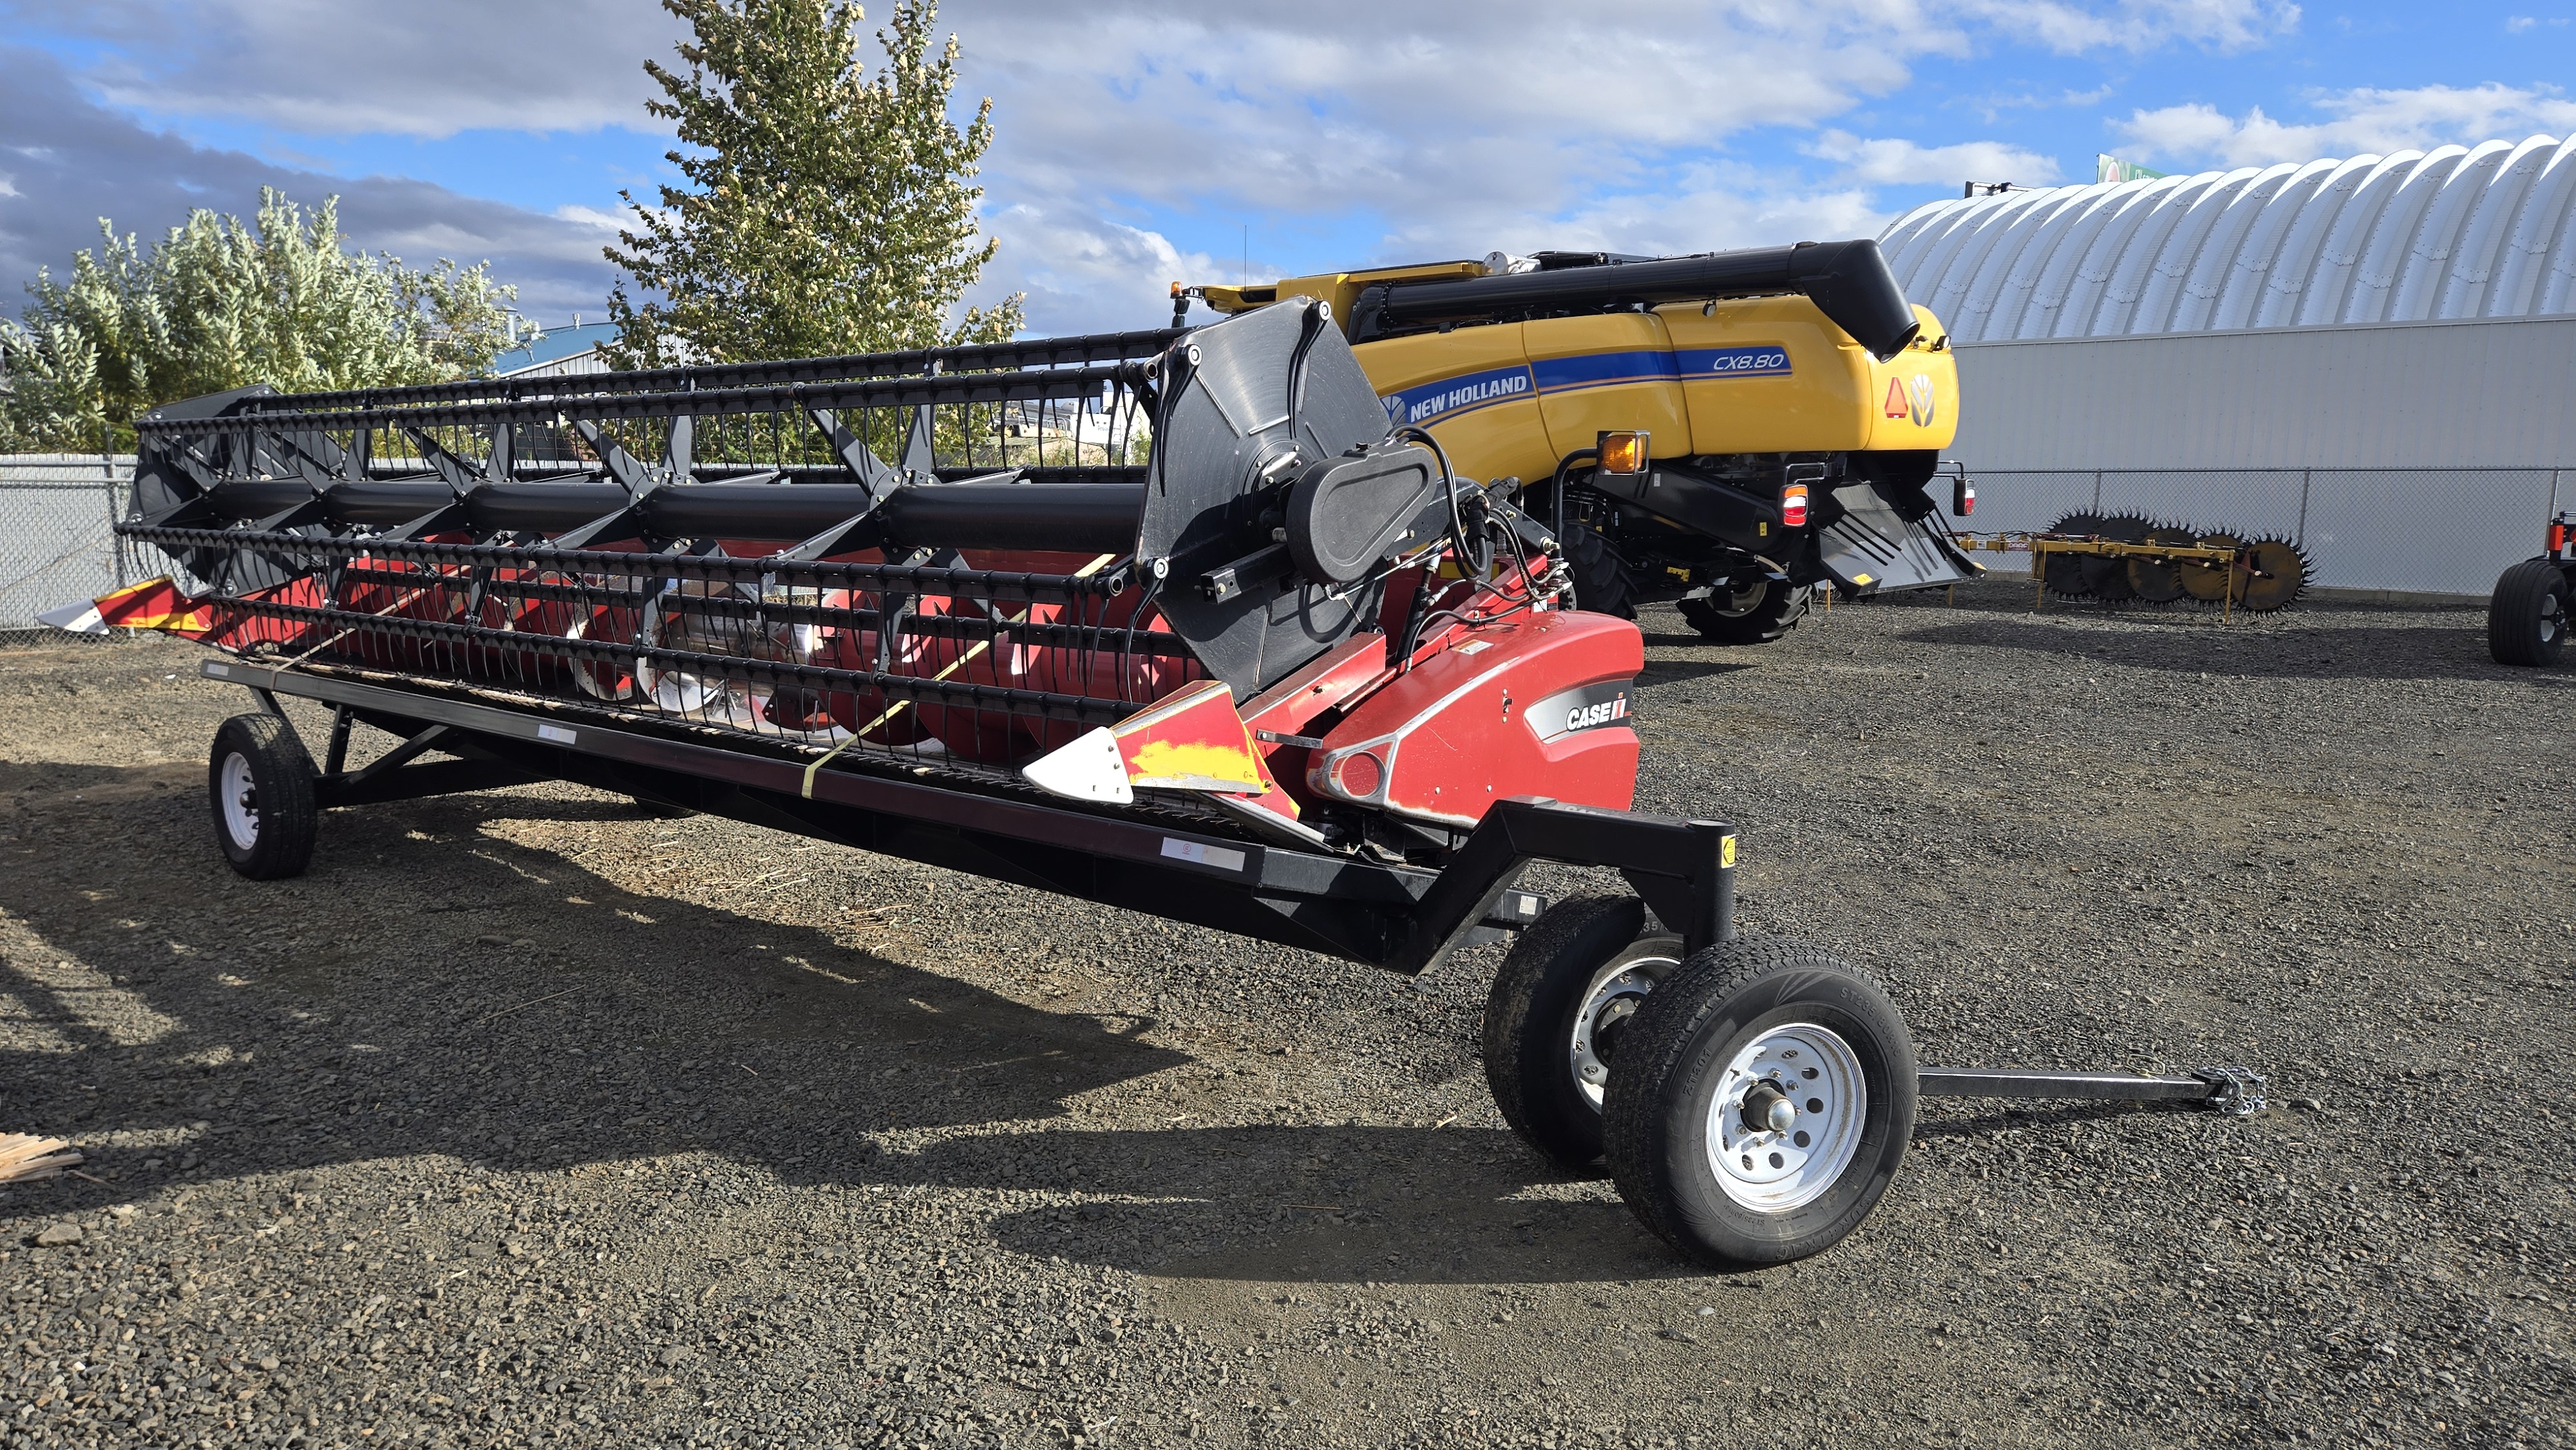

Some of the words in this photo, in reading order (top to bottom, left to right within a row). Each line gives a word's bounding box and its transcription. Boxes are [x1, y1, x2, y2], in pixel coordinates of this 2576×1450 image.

[1713, 353, 1785, 370] CX8.80
[1410, 393, 1446, 423] NEW
[1449, 375, 1527, 408] HOLLAND
[1566, 701, 1612, 731] CASE
[1682, 1048, 1713, 1096] ZT301
